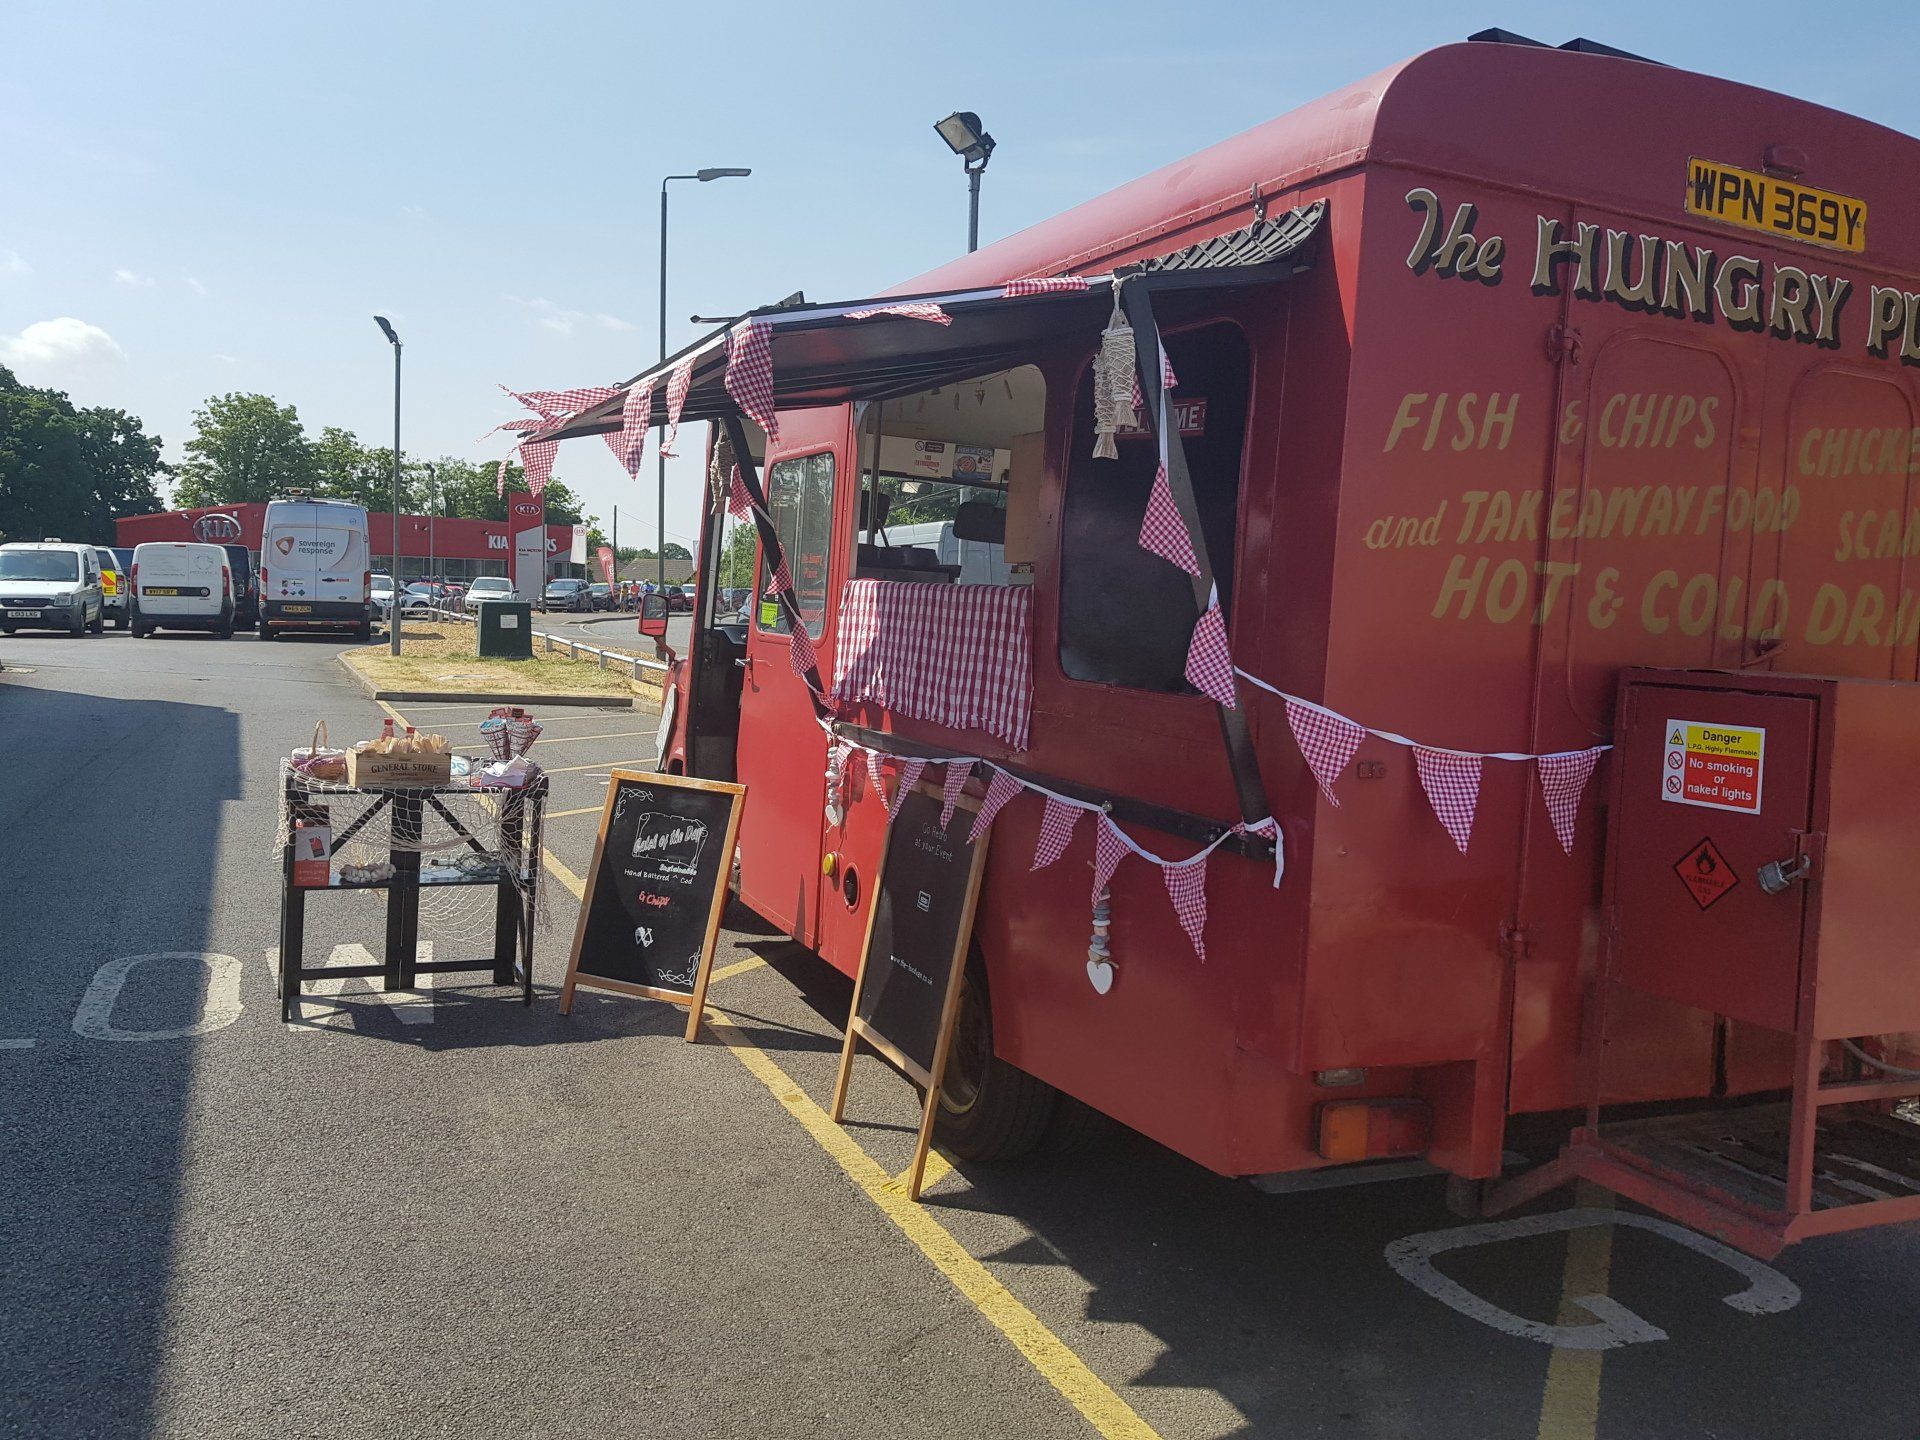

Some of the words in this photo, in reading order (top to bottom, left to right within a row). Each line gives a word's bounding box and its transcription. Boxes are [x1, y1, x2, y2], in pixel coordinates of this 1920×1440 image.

[1694, 165, 1765, 224] WPN
[1773, 187, 1861, 247] 369Y
[1404, 187, 1505, 282] The
[1531, 213, 1852, 345] HUNGRY
[1383, 392, 1520, 453] FISH
[1559, 399, 1583, 446] &
[1599, 392, 1719, 449] CHIPS
[519, 504, 537, 515] KIA
[1362, 499, 1448, 549] and
[1455, 485, 1698, 545] TAKEAWAY
[1694, 485, 1801, 536] FOOD
[201, 519, 235, 538] KIA
[298, 540, 336, 548] sovereign
[298, 547, 334, 555] response
[488, 534, 510, 550] KIA
[1432, 555, 1581, 625] HOT
[1588, 566, 1625, 630] &
[1641, 570, 1791, 643] COLD
[1702, 730, 1742, 745] Danger
[1705, 745, 1723, 753] Highly
[1724, 747, 1758, 757] Flammable
[371, 763, 410, 773] GENERAL
[412, 763, 438, 773] STORE
[1689, 757, 1704, 769] No
[1707, 761, 1754, 778] smoking
[1713, 775, 1726, 784] or
[1687, 783, 1718, 796] naked
[1722, 786, 1752, 801] lights
[658, 833, 670, 850] of
[669, 827, 684, 845] the
[935, 844, 953, 863] Event
[624, 868, 643, 878] Hand
[643, 871, 670, 882] Battered
[680, 876, 694, 885] Cod
